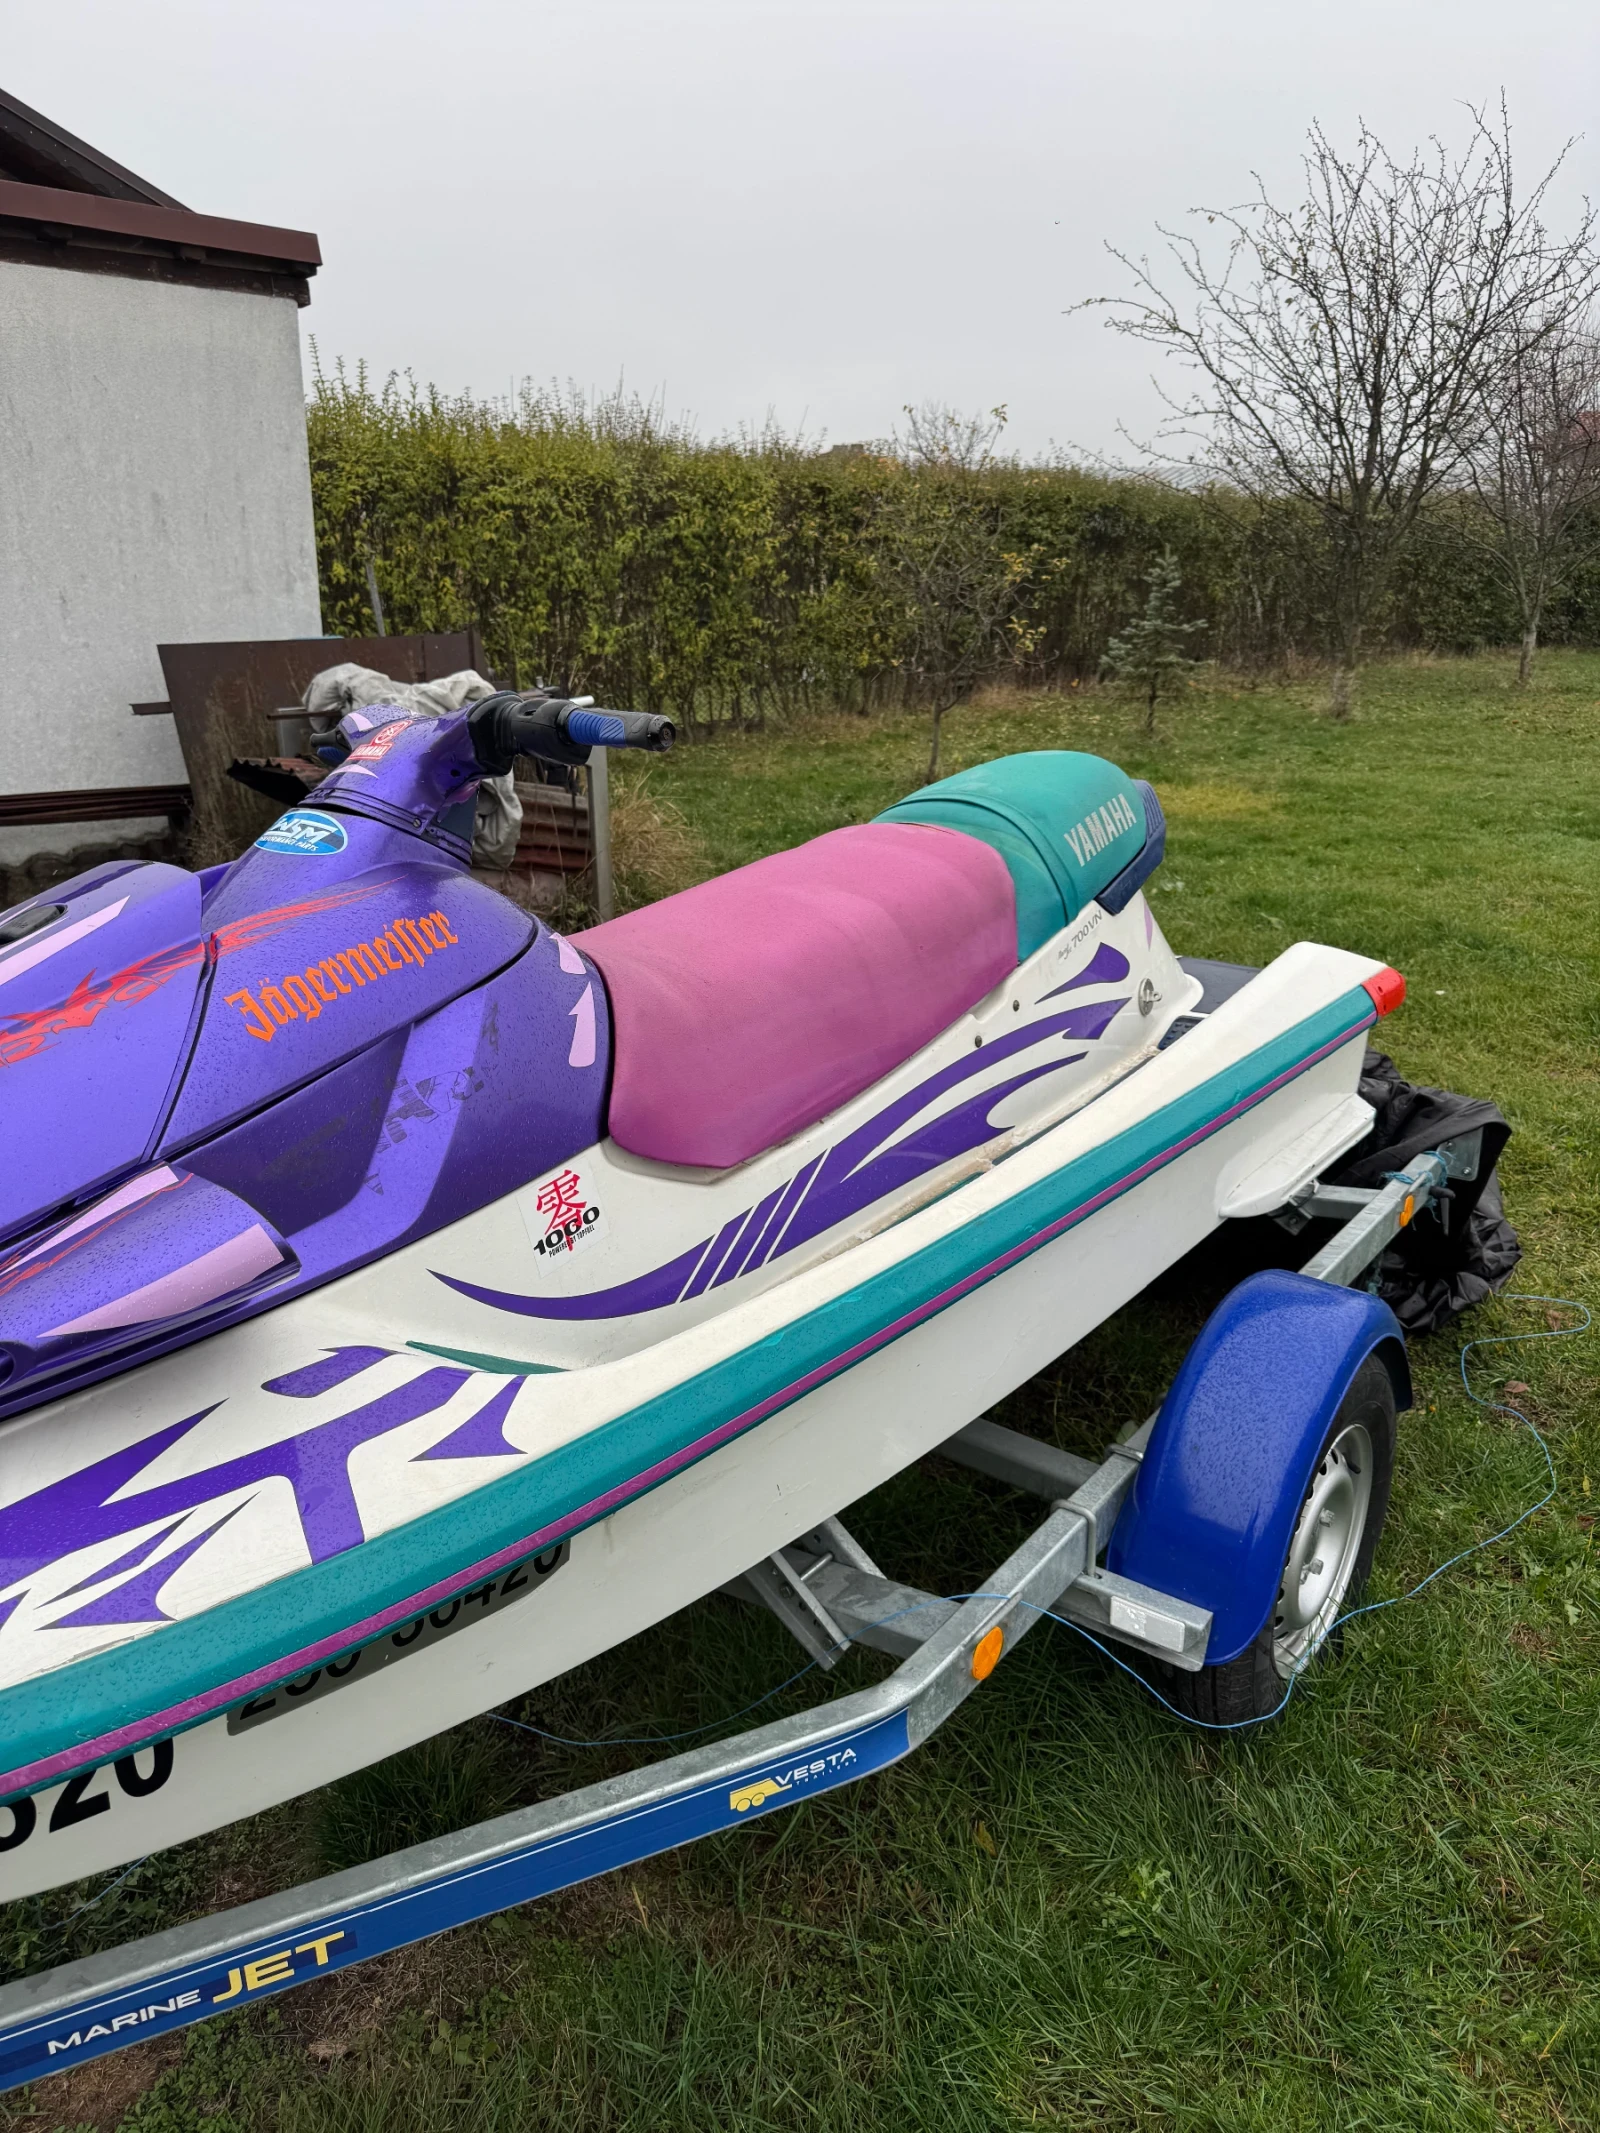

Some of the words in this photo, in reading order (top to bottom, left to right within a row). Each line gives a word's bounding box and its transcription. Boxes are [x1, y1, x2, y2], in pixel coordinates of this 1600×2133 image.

[1064, 793, 1137, 867] YAMAHA
[533, 1206, 600, 1255] 1000
[775, 1748, 857, 1785] VESTA
[48, 1989, 201, 2056] MARINE
[212, 1930, 345, 2004] JET
